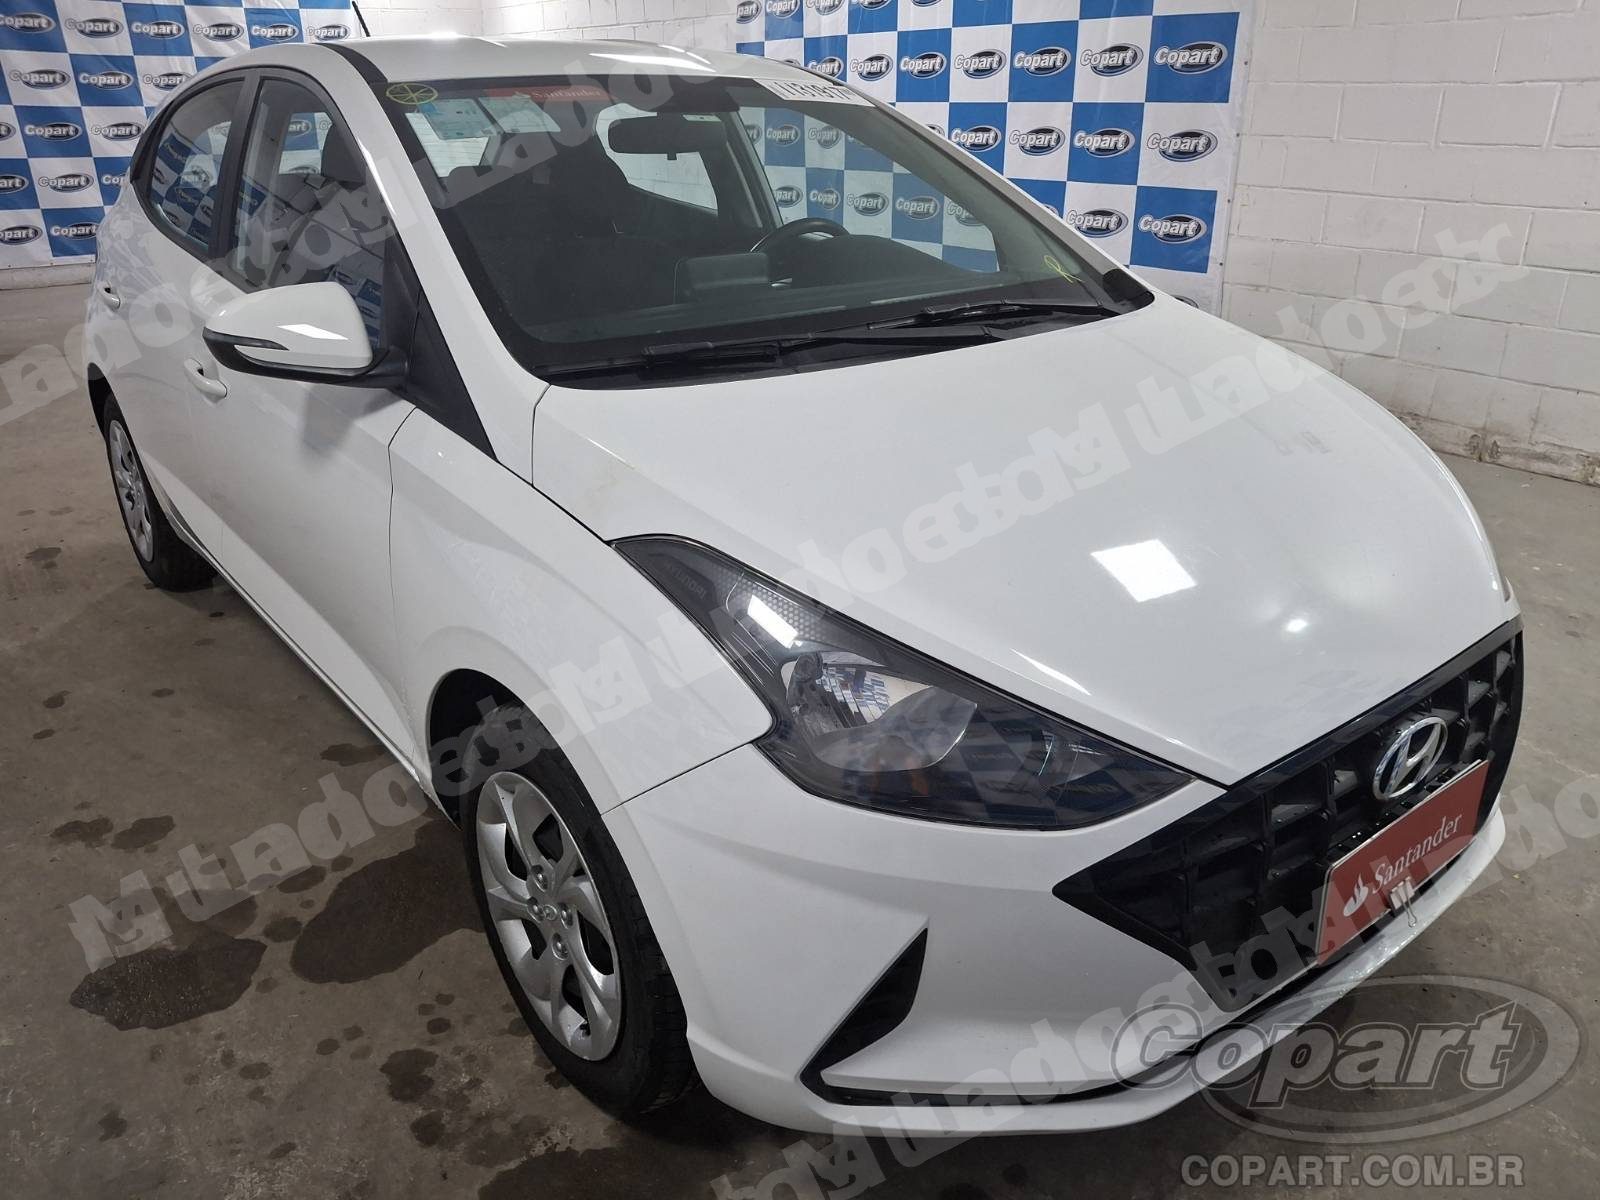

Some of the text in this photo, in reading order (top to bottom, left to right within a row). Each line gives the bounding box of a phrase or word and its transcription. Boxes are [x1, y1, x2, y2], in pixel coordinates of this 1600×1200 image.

[737, 4, 757, 16] part
[64, 18, 117, 33] Copart
[131, 22, 179, 35] Copart
[193, 24, 238, 37] Copart
[251, 25, 293, 37] Copart
[307, 26, 346, 38] Copart
[900, 55, 942, 71] Copart
[954, 53, 1000, 71] Copart
[1014, 51, 1065, 69] Copart
[1079, 48, 1135, 67] Copart
[1155, 46, 1219, 66] Copart
[850, 58, 887, 73] Copart
[9, 69, 62, 85] Copart
[79, 72, 128, 87] Copart
[24, 124, 76, 138] Copart
[91, 125, 138, 138] Copart
[766, 127, 796, 142] Copart
[951, 127, 997, 148] Copart
[1009, 129, 1058, 149] Copart
[1073, 130, 1127, 150] Copart
[1147, 132, 1206, 154] Copart
[38, 176, 87, 189] Copart
[847, 194, 883, 210] Copart
[895, 197, 935, 215] Copart
[1067, 209, 1118, 233] Copart
[1138, 215, 1198, 237] Copart
[1372, 814, 1462, 894] Santander
